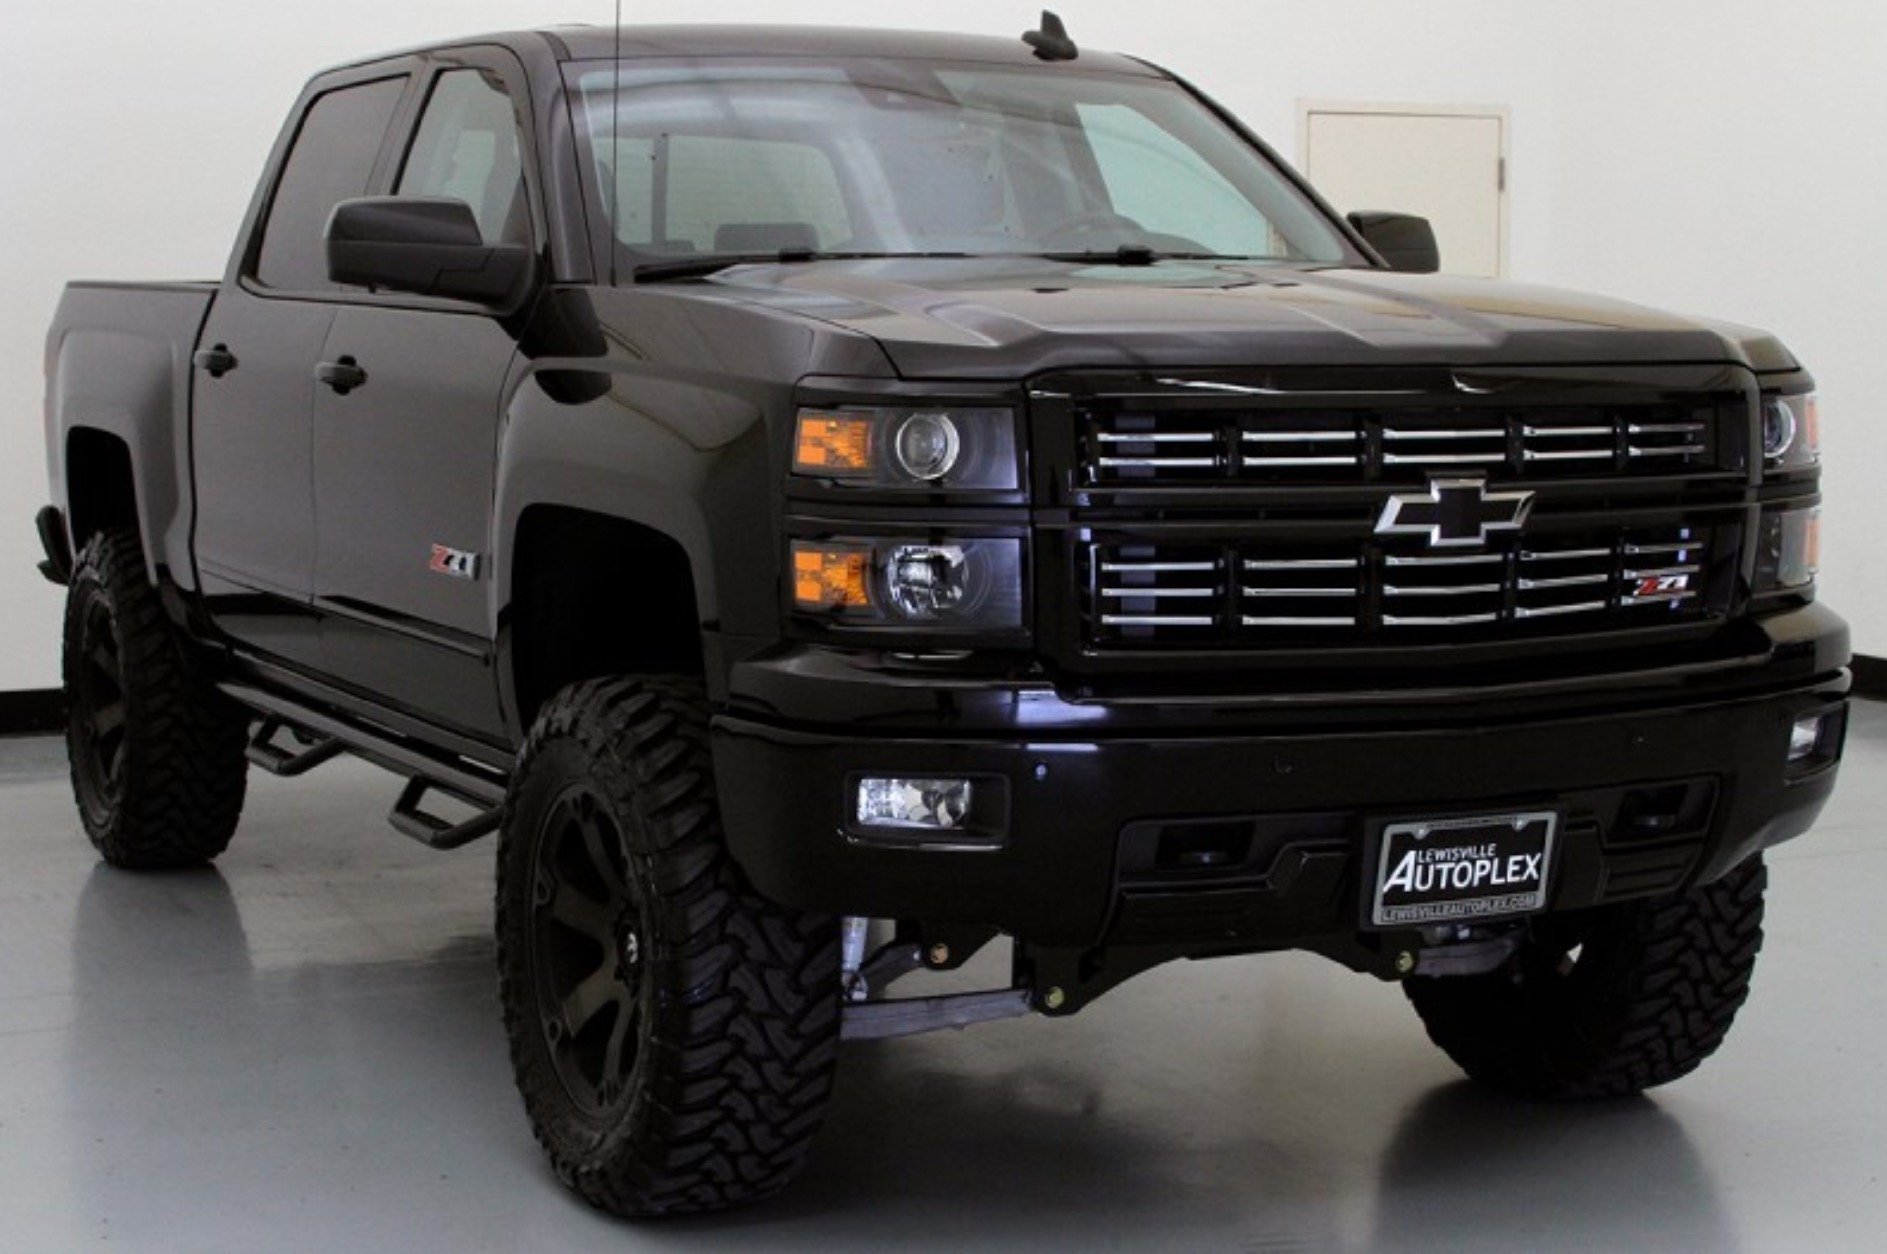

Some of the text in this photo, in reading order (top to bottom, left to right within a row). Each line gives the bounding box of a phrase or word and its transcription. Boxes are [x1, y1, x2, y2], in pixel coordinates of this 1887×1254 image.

[430, 543, 477, 579] Z71
[1633, 574, 1688, 596] Z71
[1417, 843, 1496, 863] LEWISVILLE
[1383, 851, 1542, 892] AUTOPLEX
